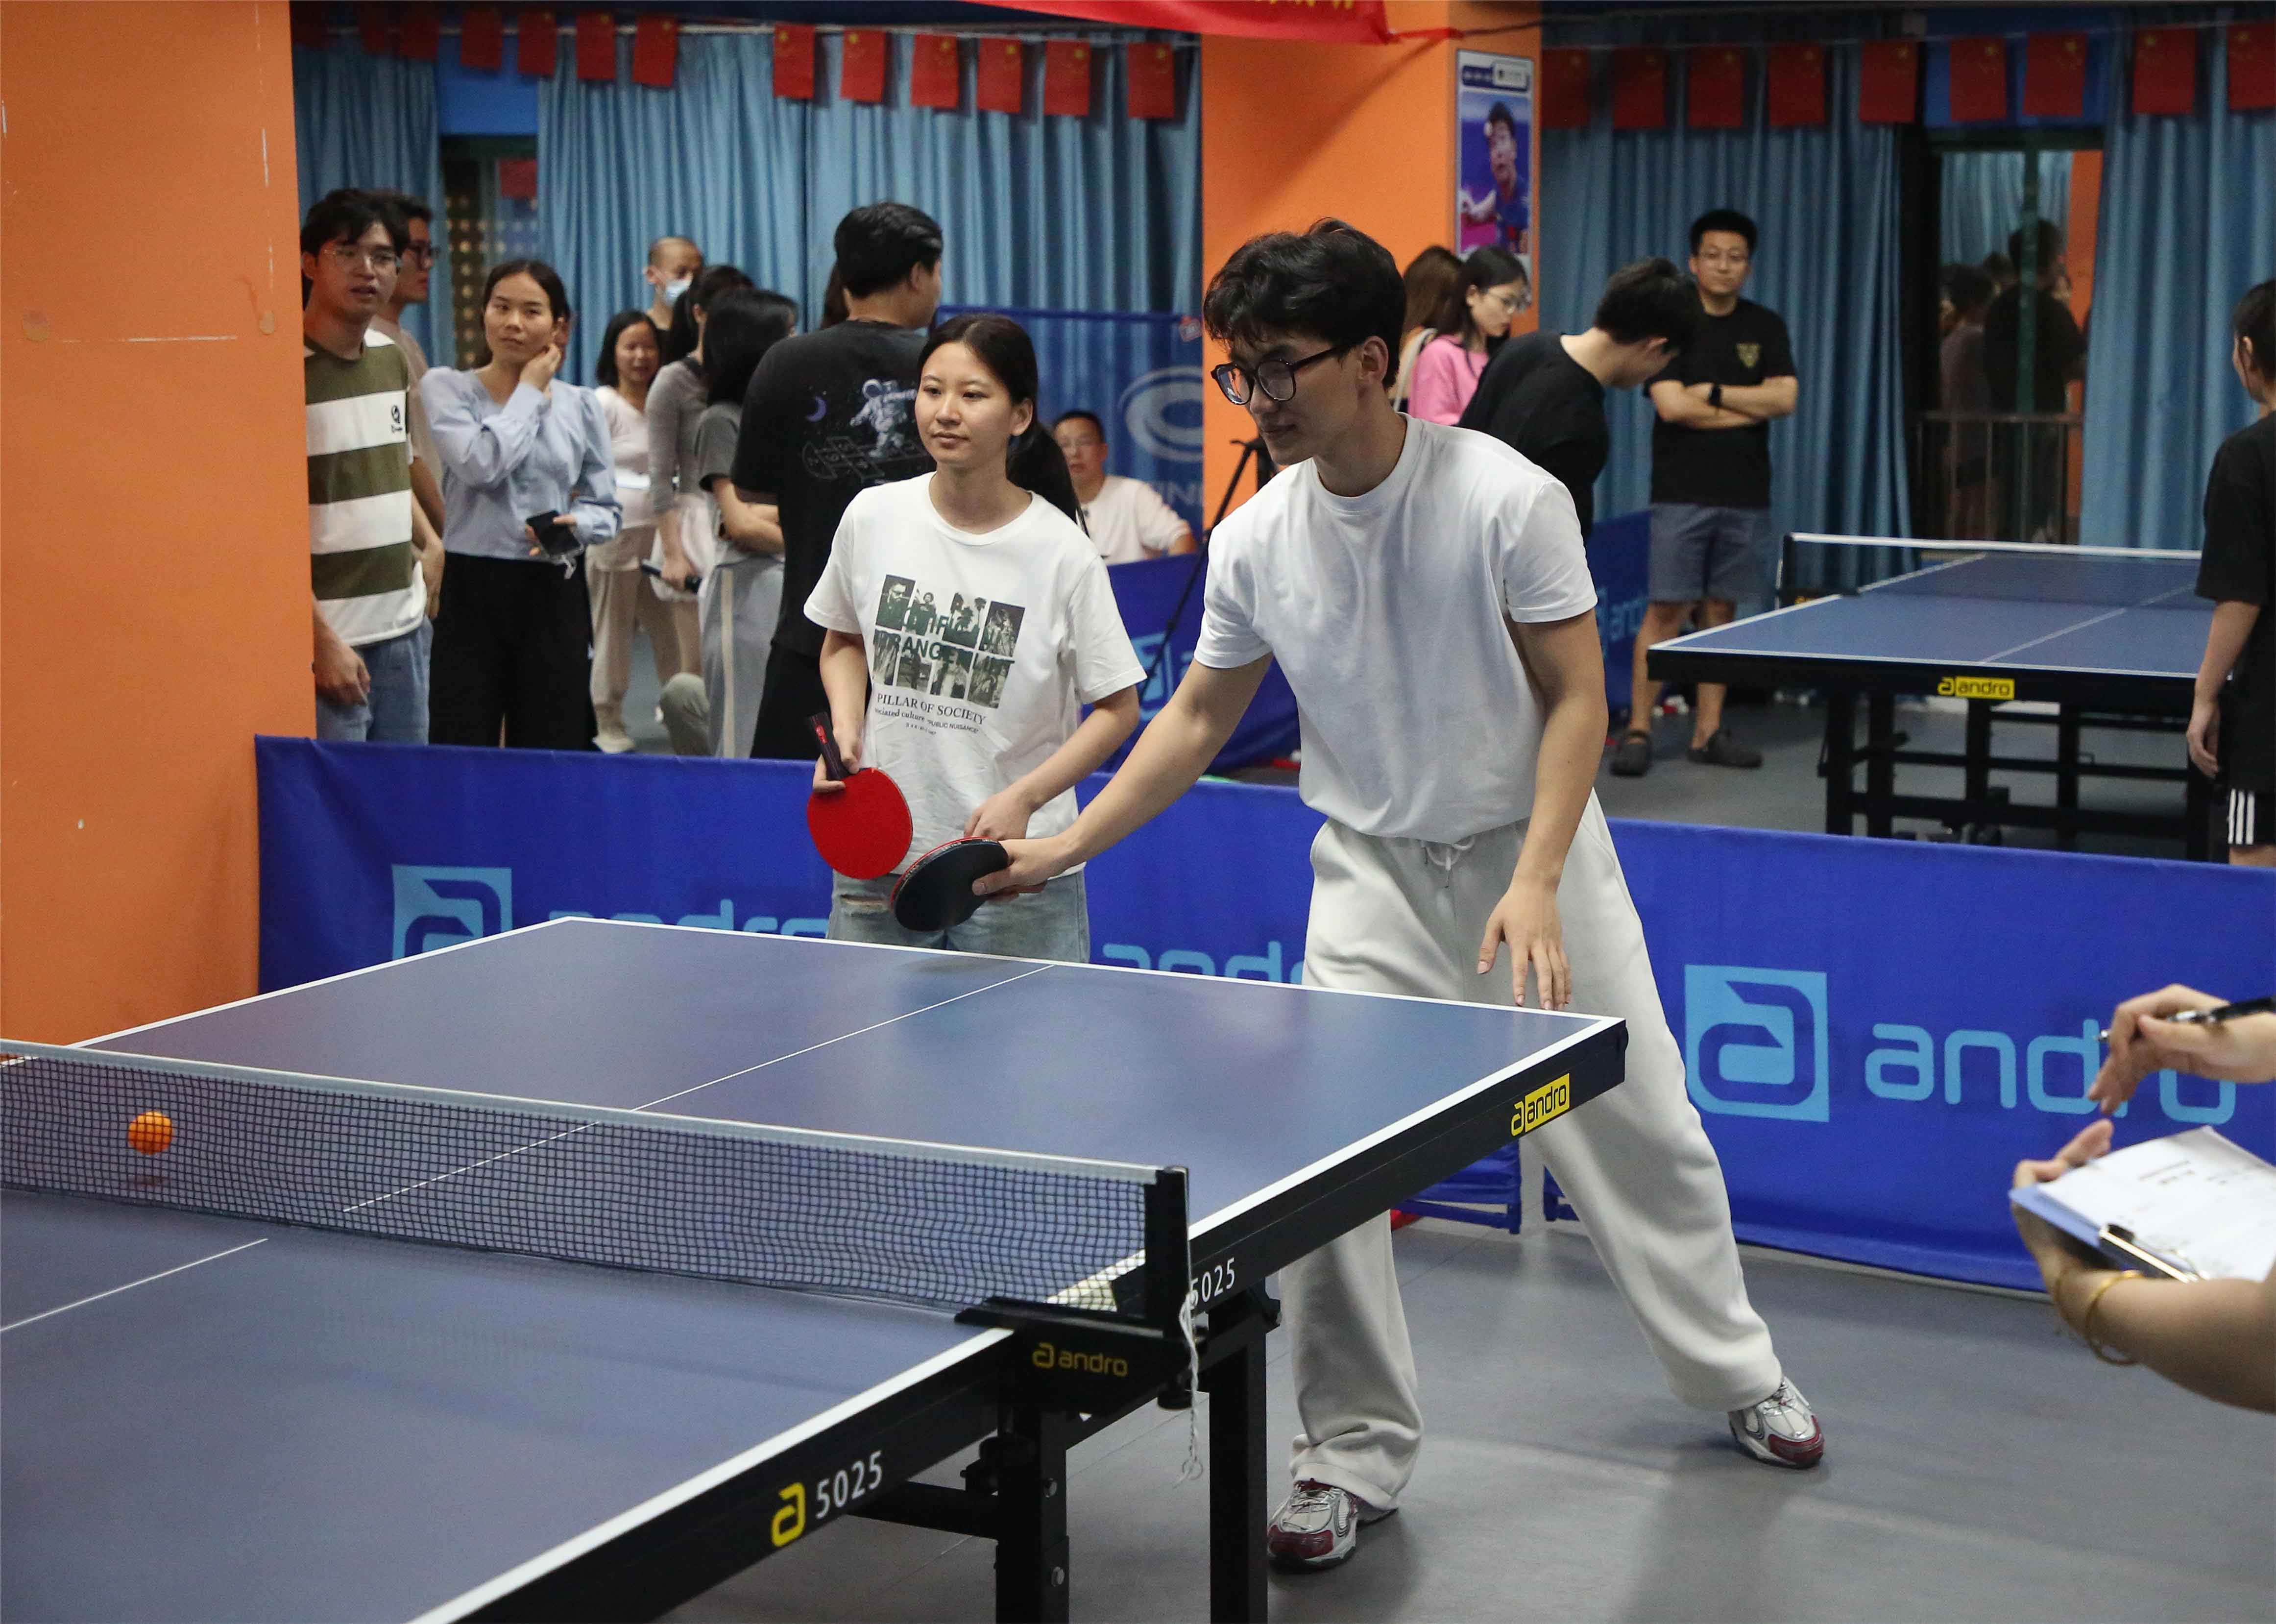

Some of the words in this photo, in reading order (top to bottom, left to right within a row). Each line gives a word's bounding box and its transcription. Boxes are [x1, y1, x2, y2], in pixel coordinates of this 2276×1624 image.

[1958, 681, 2010, 696] andro
[877, 693, 918, 709] PILLAR
[920, 701, 935, 713] OF
[937, 704, 987, 725] SOCIETY
[901, 710, 925, 722] culture
[1864, 1019, 2237, 1125] ando
[1527, 1084, 1567, 1124] andro
[1188, 1257, 1235, 1309] 5025
[1058, 1350, 1127, 1377] andro
[816, 1450, 882, 1519] 5025
